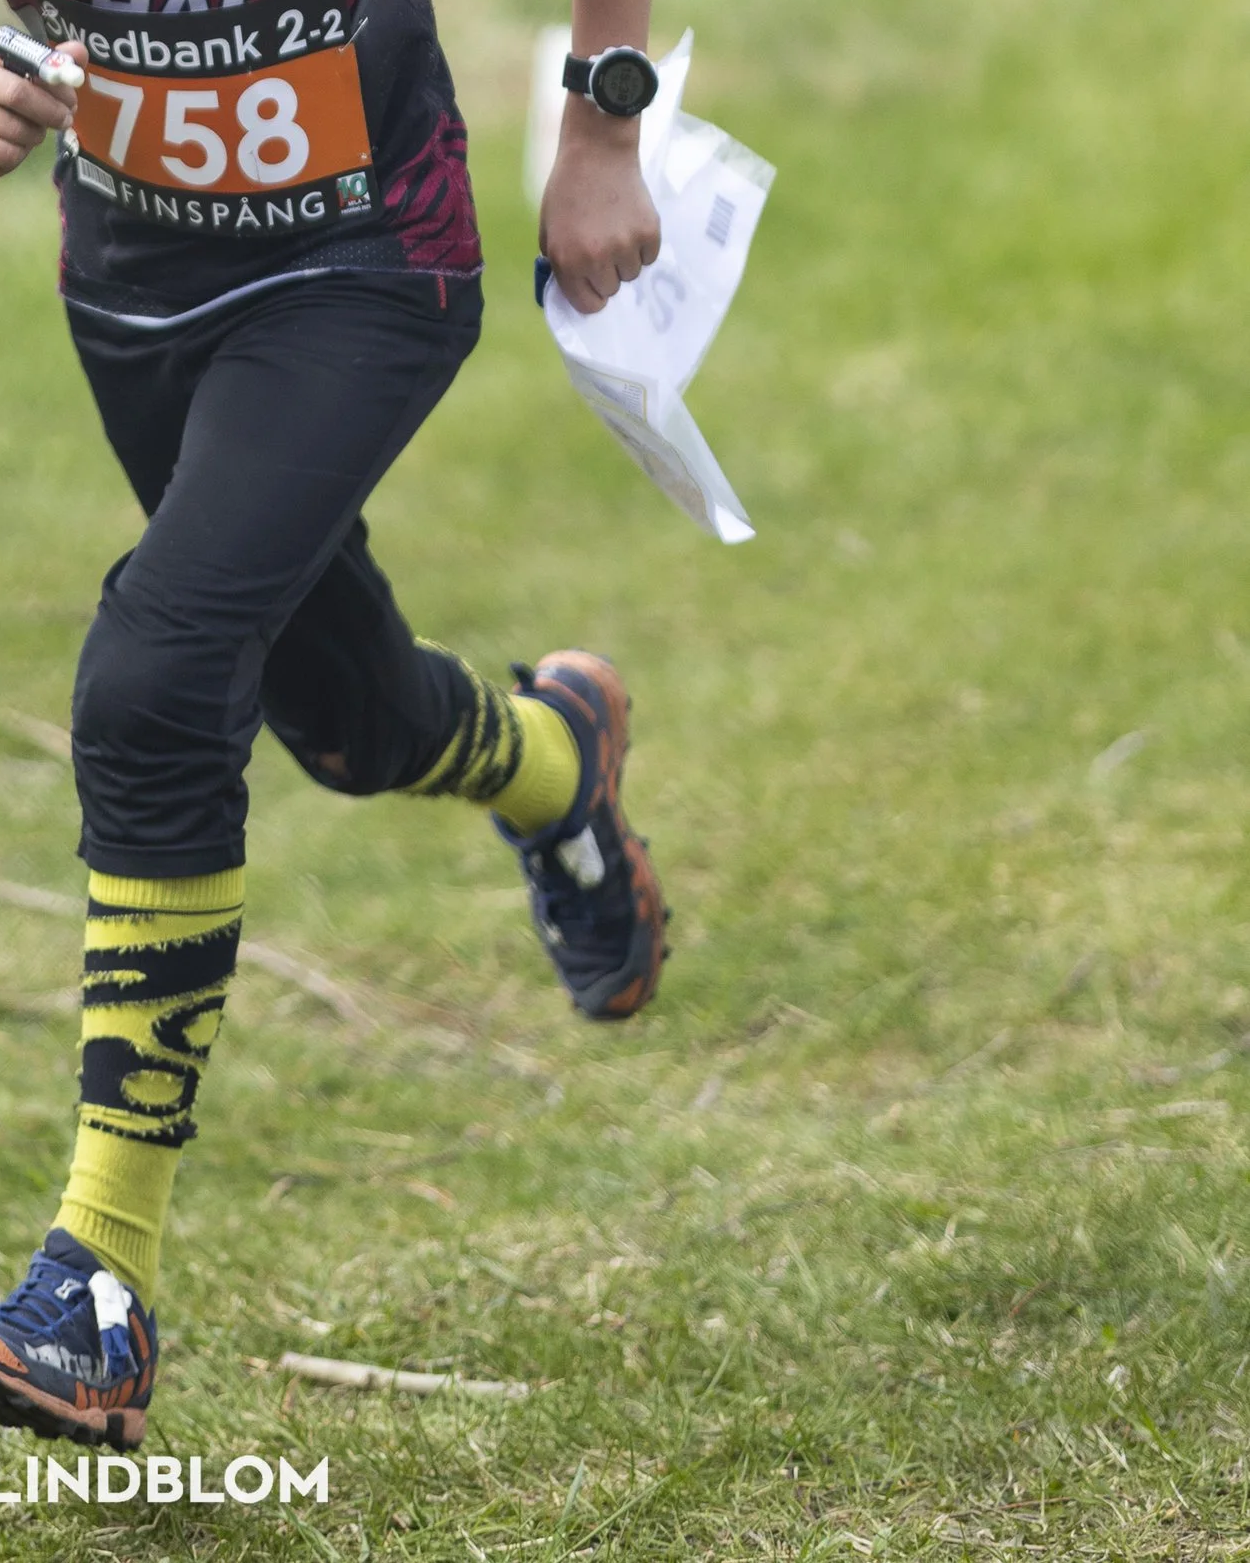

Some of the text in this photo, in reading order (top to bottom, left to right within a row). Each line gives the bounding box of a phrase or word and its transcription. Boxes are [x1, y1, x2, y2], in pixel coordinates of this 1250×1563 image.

[42, 0, 346, 69] Swedbank 2-2
[88, 77, 310, 187] 758
[119, 180, 327, 228] FINSPÅNG
[337, 174, 367, 201] 10
